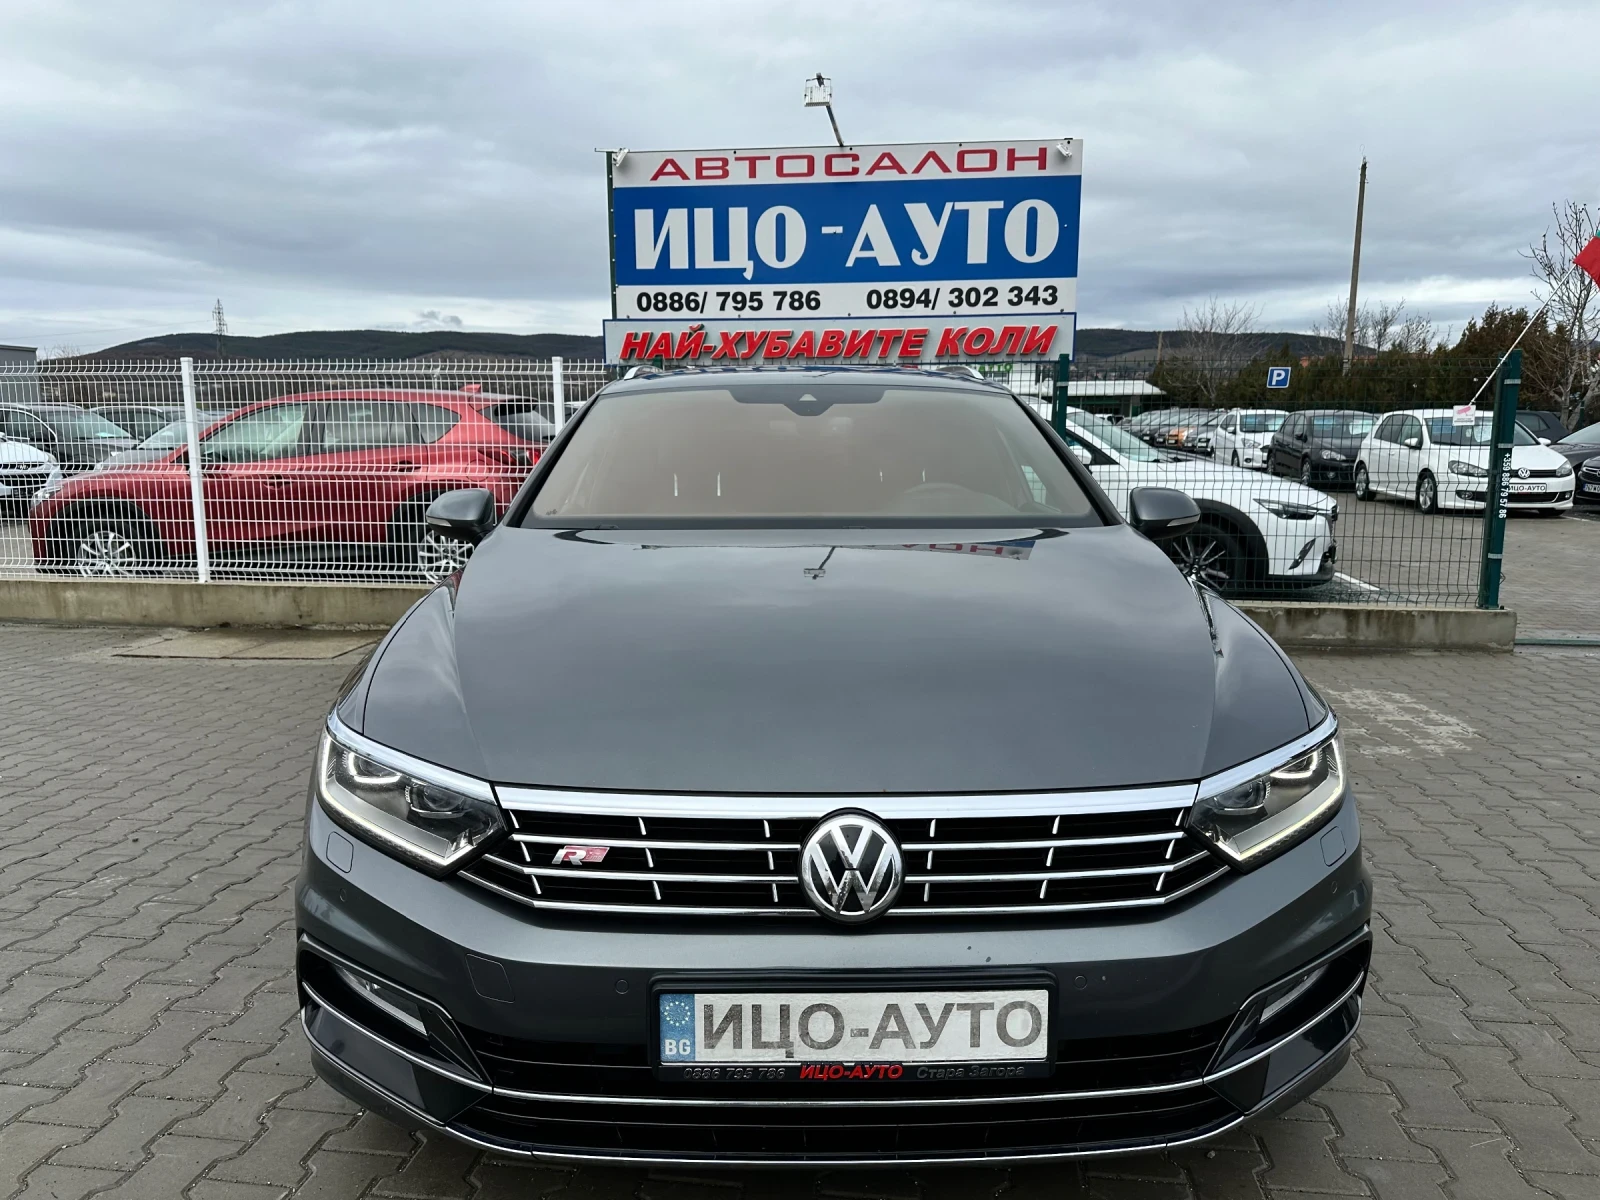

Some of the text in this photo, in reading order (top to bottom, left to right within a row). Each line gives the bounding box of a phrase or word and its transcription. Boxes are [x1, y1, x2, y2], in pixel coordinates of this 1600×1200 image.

[649, 147, 1048, 182] АВТОСАЛОН
[635, 289, 822, 314] 0886/ 795 786
[866, 285, 1059, 311] 0894/ 302 343
[618, 323, 1059, 361] НАЙ-ХУБАВИТЕ КОЛИ
[1271, 369, 1286, 386] P
[1498, 452, 1512, 519] +359 886 79 57 86
[702, 1000, 1043, 1059] ИЦО-АУТО
[664, 1038, 691, 1055] BG
[683, 1067, 786, 1080] 0886 795 786
[800, 1064, 904, 1081] ИЦО-АУТО
[916, 1065, 1026, 1080] Стара Загора
